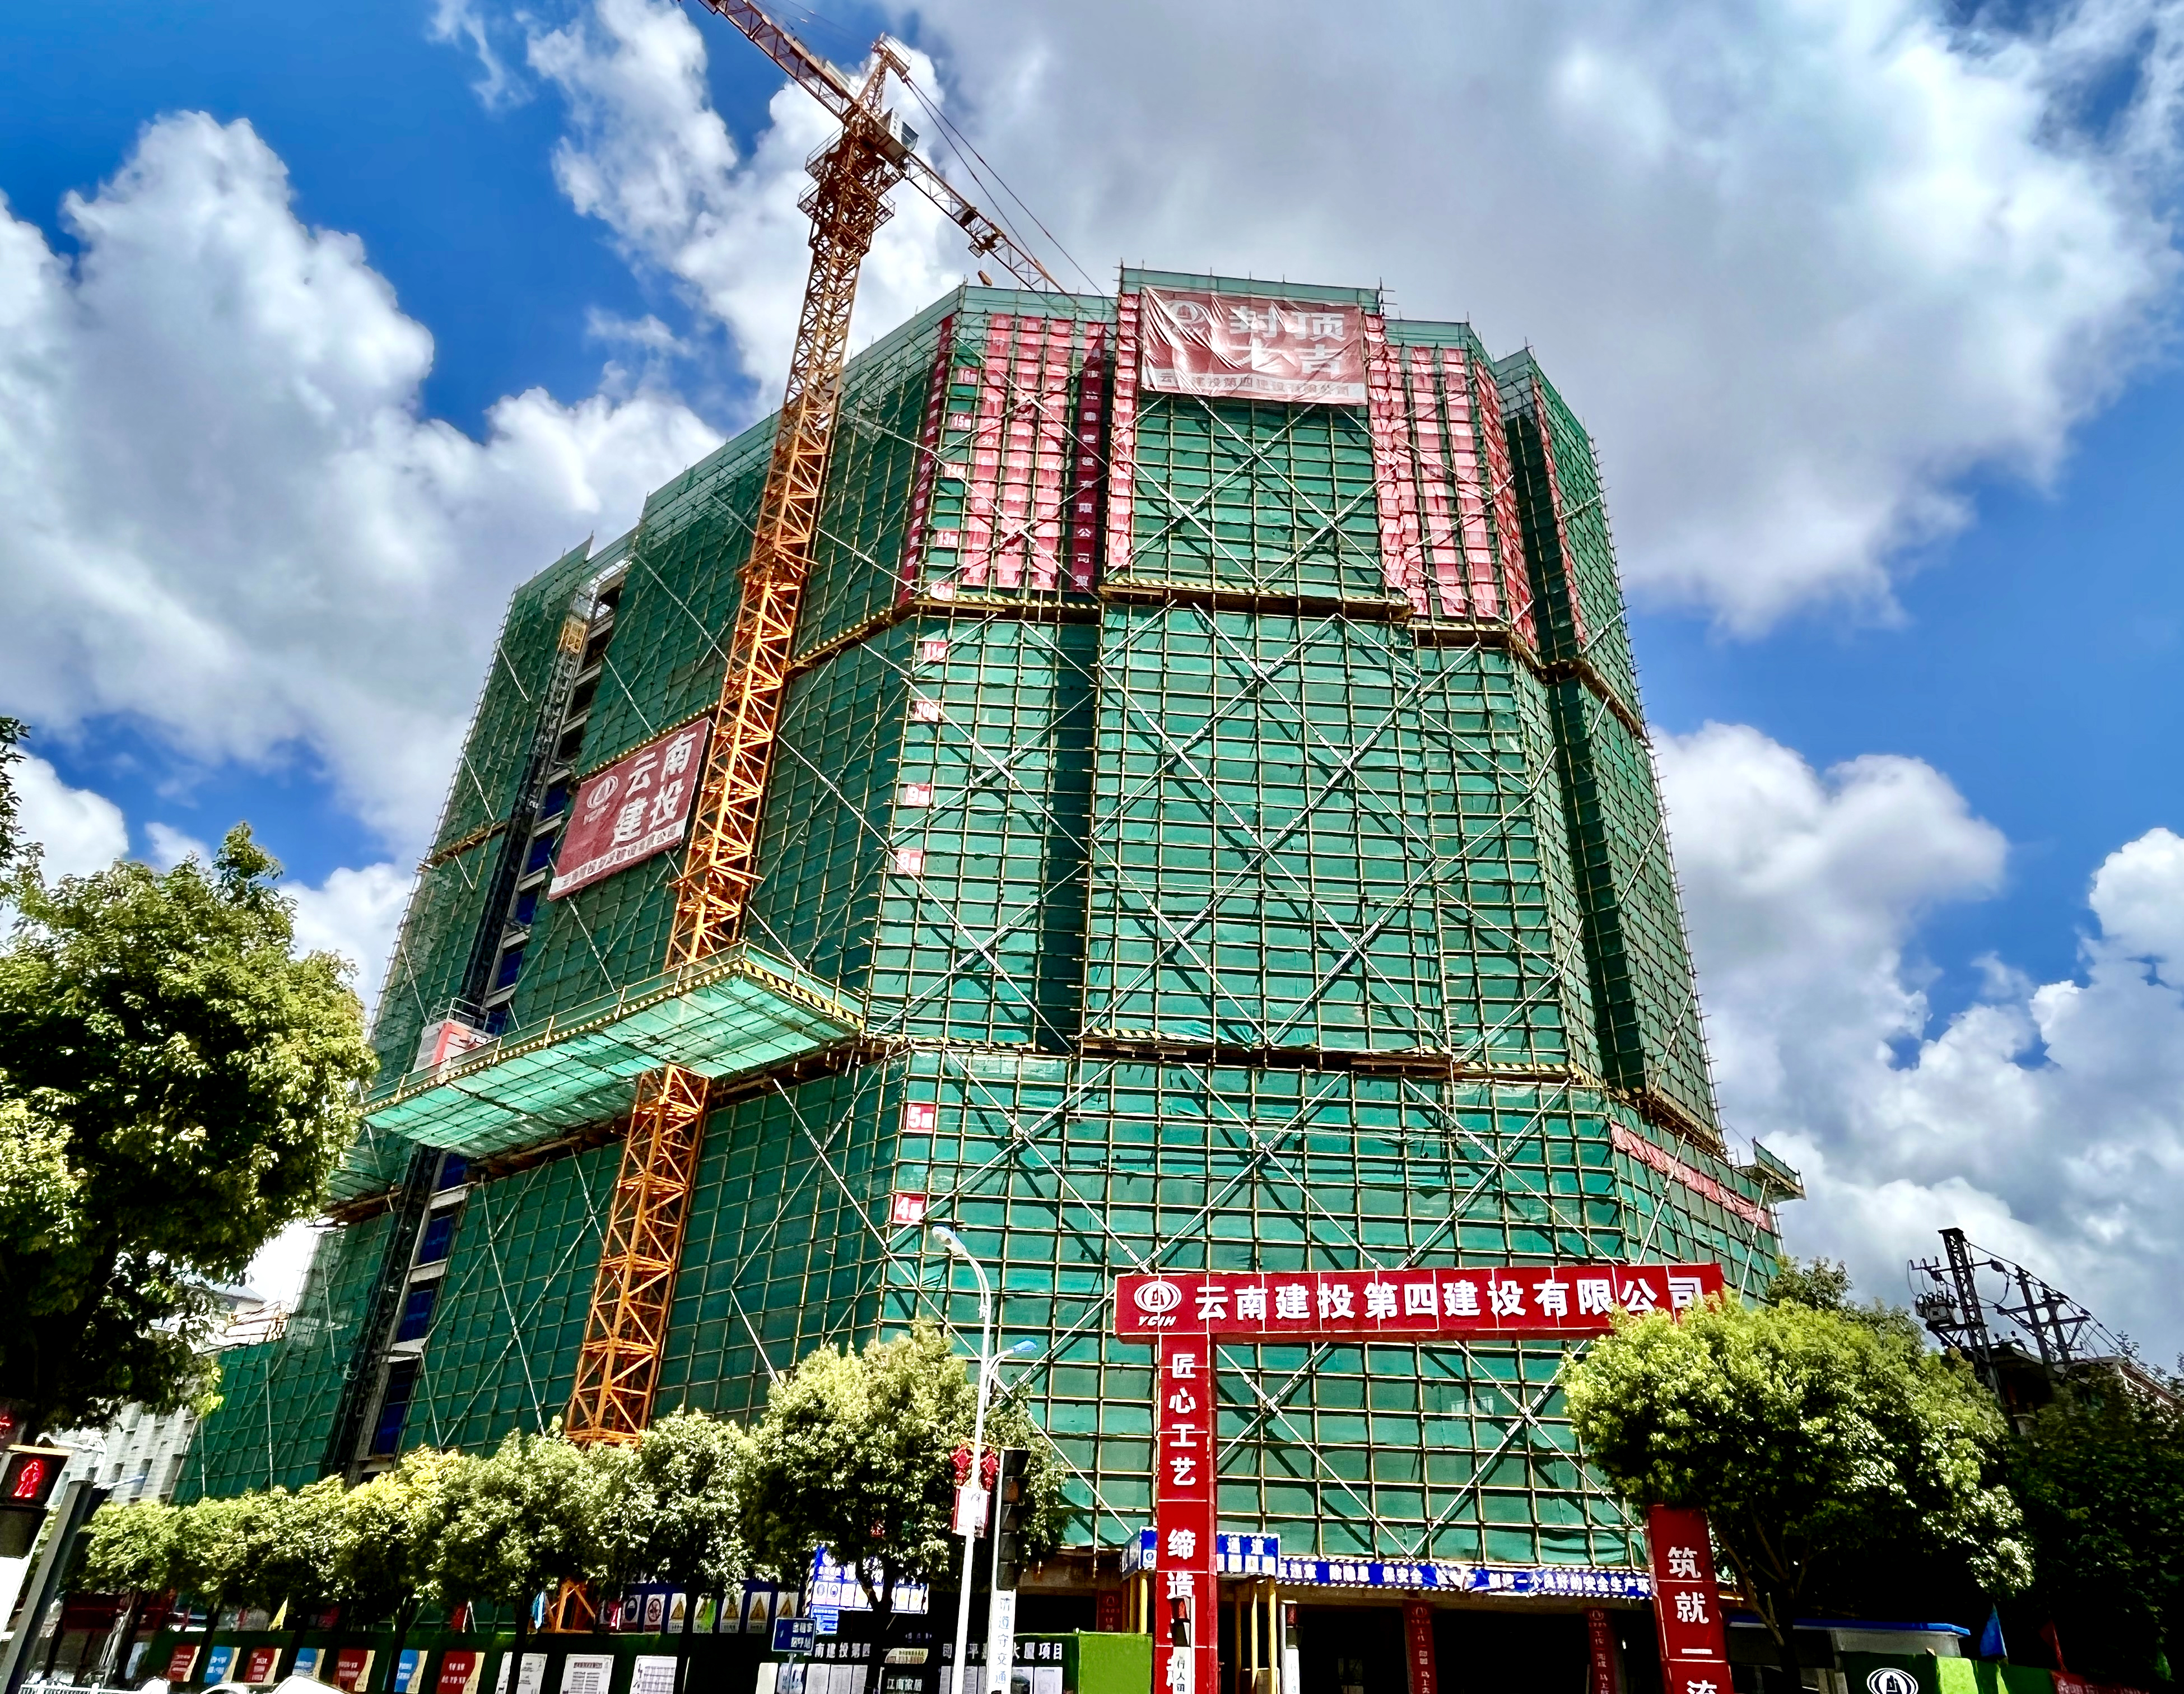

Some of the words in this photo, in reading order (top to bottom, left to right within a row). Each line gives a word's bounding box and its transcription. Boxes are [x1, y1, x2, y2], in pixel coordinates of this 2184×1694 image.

[1229, 306, 1345, 342] 封顶
[626, 732, 697, 798] 云南
[610, 779, 684, 846] 建投
[1138, 1316, 1177, 1327] YCIH
[1195, 1277, 1703, 1320] 云南建投第四建设有限公司
[1168, 1353, 1197, 1486] 匠心工艺
